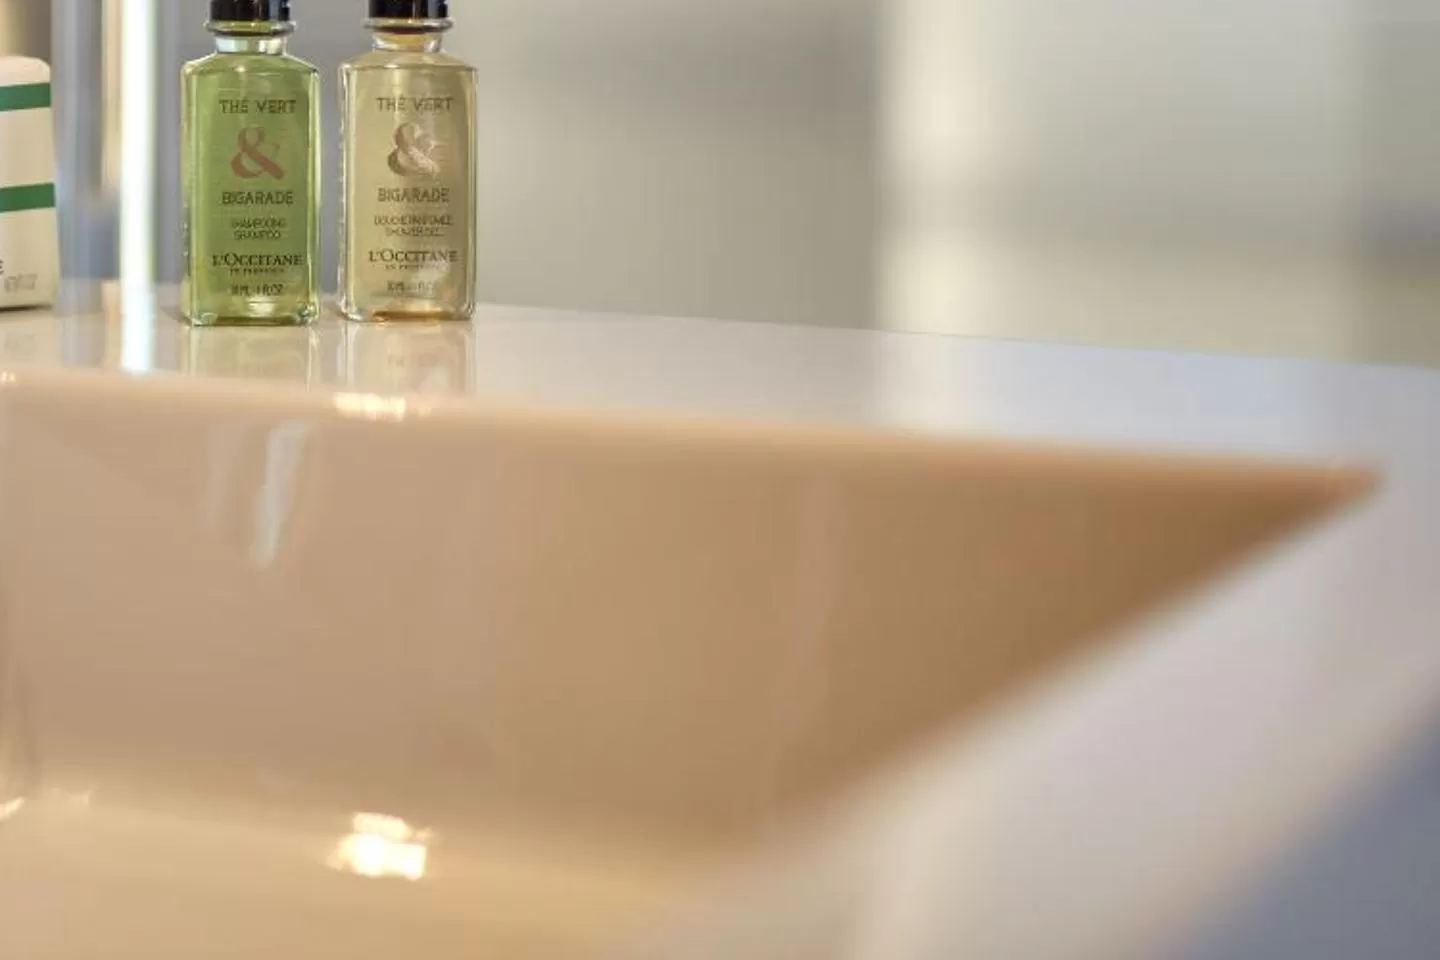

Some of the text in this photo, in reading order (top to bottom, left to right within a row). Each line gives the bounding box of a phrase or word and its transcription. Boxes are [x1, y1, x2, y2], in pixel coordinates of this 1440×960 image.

[255, 99, 297, 113] VERT
[413, 96, 454, 112] VERT
[231, 126, 285, 180] &
[221, 191, 293, 205] BIGARADE
[378, 188, 450, 202] BIGARADE
[212, 253, 304, 267] L'OCCITANE
[368, 249, 458, 262] L'OCCITANE
